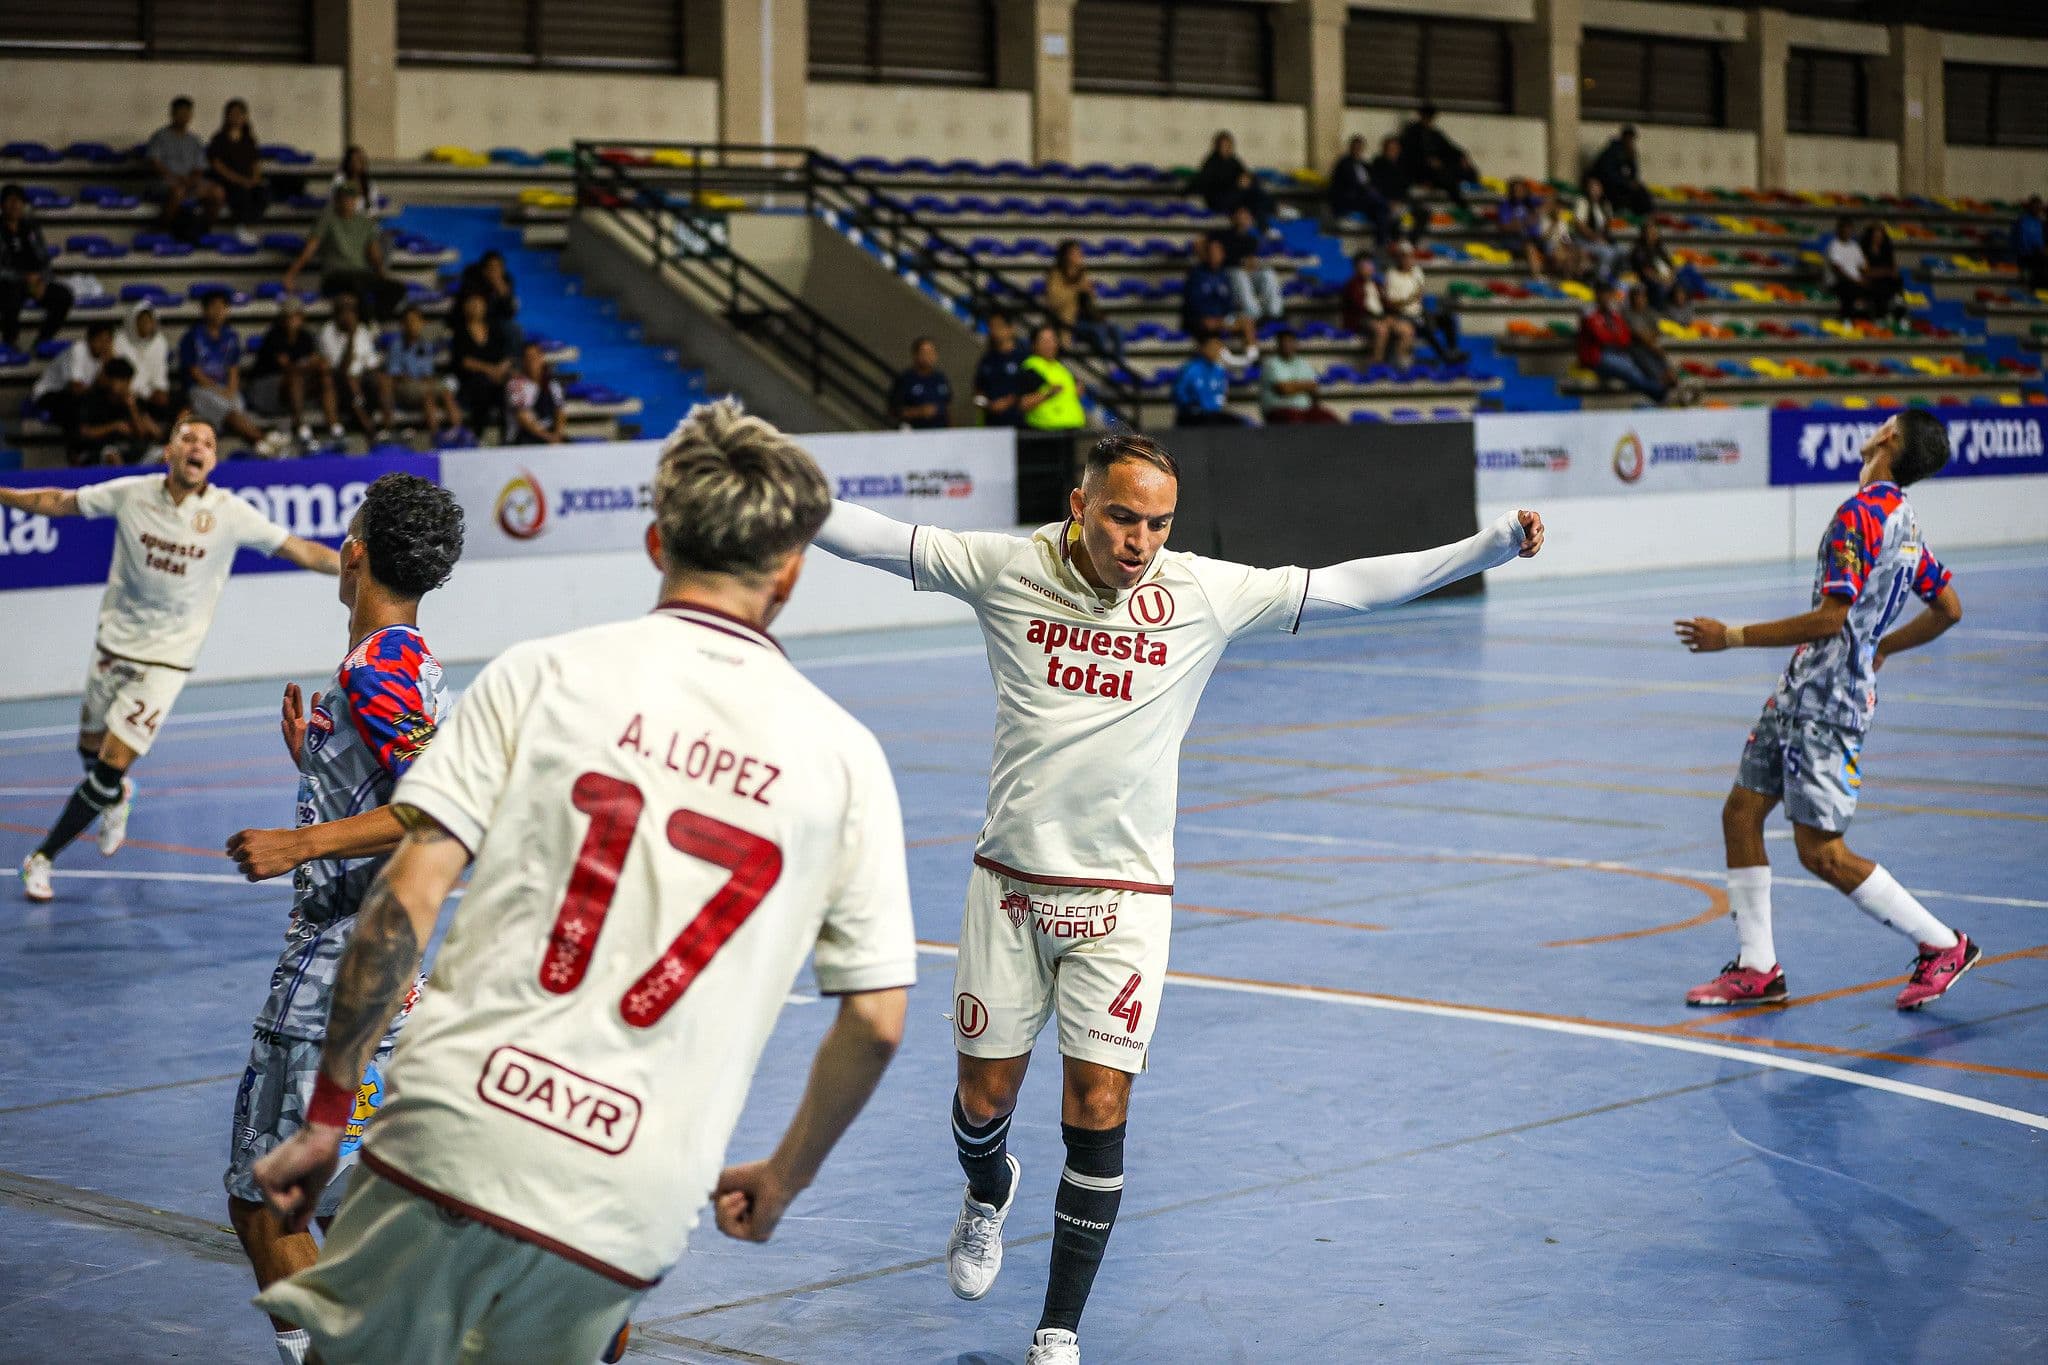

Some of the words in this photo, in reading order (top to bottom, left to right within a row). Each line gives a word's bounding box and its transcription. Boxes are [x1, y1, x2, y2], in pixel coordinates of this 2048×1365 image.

[1019, 575, 1080, 612] marathon
[1026, 619, 1168, 666] apuesta
[1046, 656, 1133, 701] total
[126, 698, 161, 736] 24
[617, 712, 651, 758] A.
[665, 728, 782, 807] LÓPEZ
[539, 771, 784, 1029] 17
[1107, 972, 1143, 1034] 4
[1087, 1027, 1145, 1051] marathon
[495, 1062, 626, 1138] DAYR
[1055, 1210, 1111, 1231] marathon
